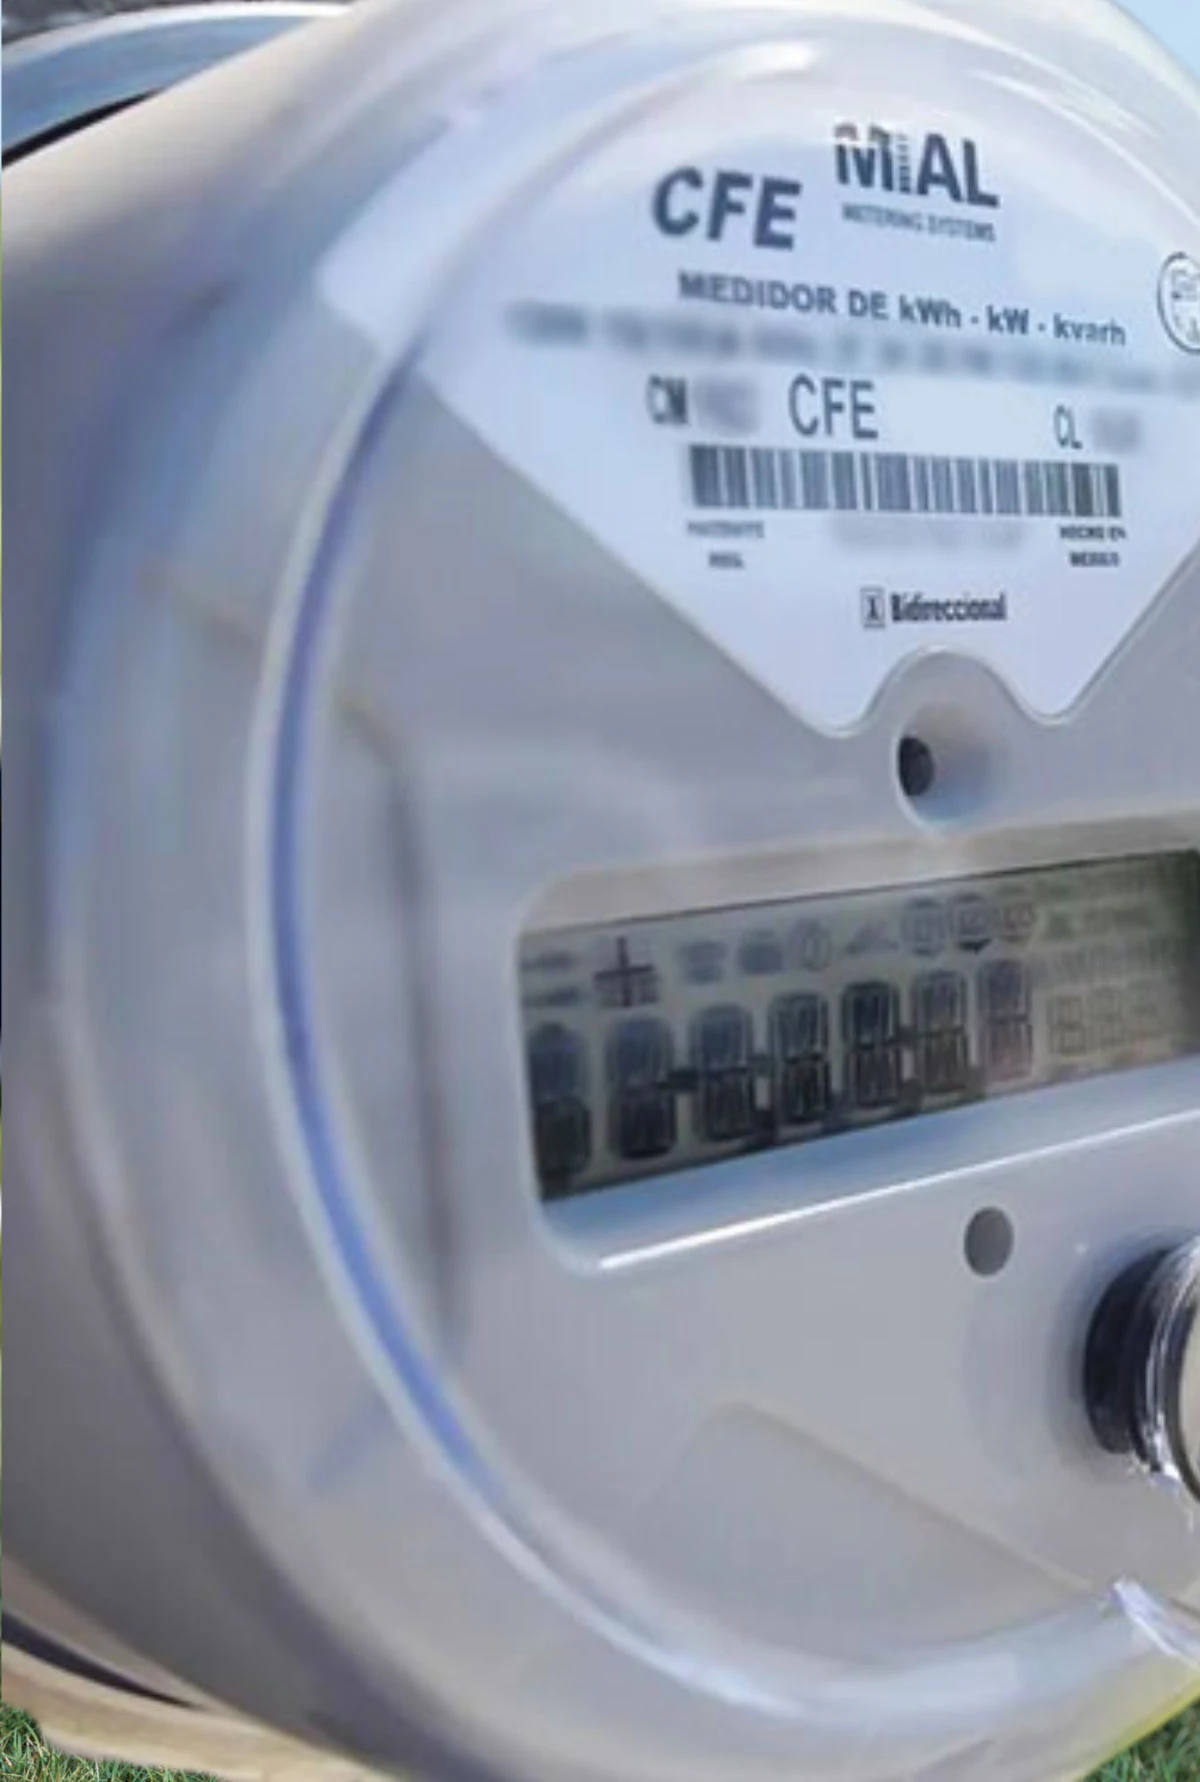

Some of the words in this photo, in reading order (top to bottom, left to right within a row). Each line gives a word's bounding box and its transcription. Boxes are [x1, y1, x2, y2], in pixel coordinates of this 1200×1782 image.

[652, 166, 802, 251] CFE
[680, 269, 837, 314] MEDIDOR
[848, 287, 889, 321] DE
[899, 295, 961, 328] kWh
[986, 304, 1029, 335] kW
[1053, 313, 1126, 346] kvarh
[788, 374, 880, 441] CFE
[891, 591, 1007, 622] Bidireccional
